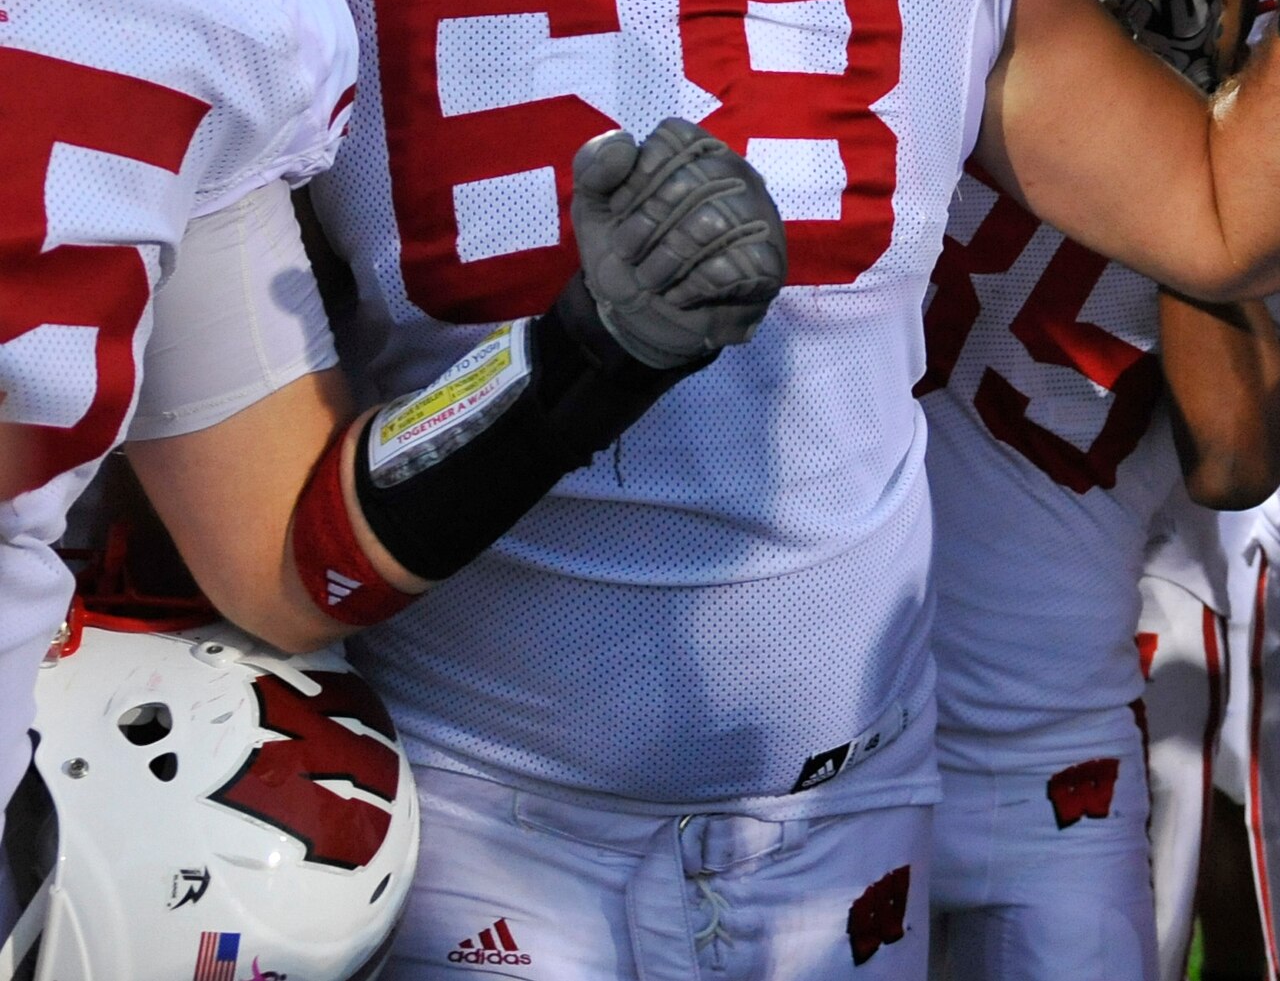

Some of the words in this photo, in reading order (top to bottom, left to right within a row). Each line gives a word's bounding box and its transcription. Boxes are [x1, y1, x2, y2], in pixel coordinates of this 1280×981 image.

[396, 407, 456, 444] TOGETHER
[457, 401, 467, 415] A
[467, 383, 496, 407] WALL
[447, 947, 532, 966] adidas
